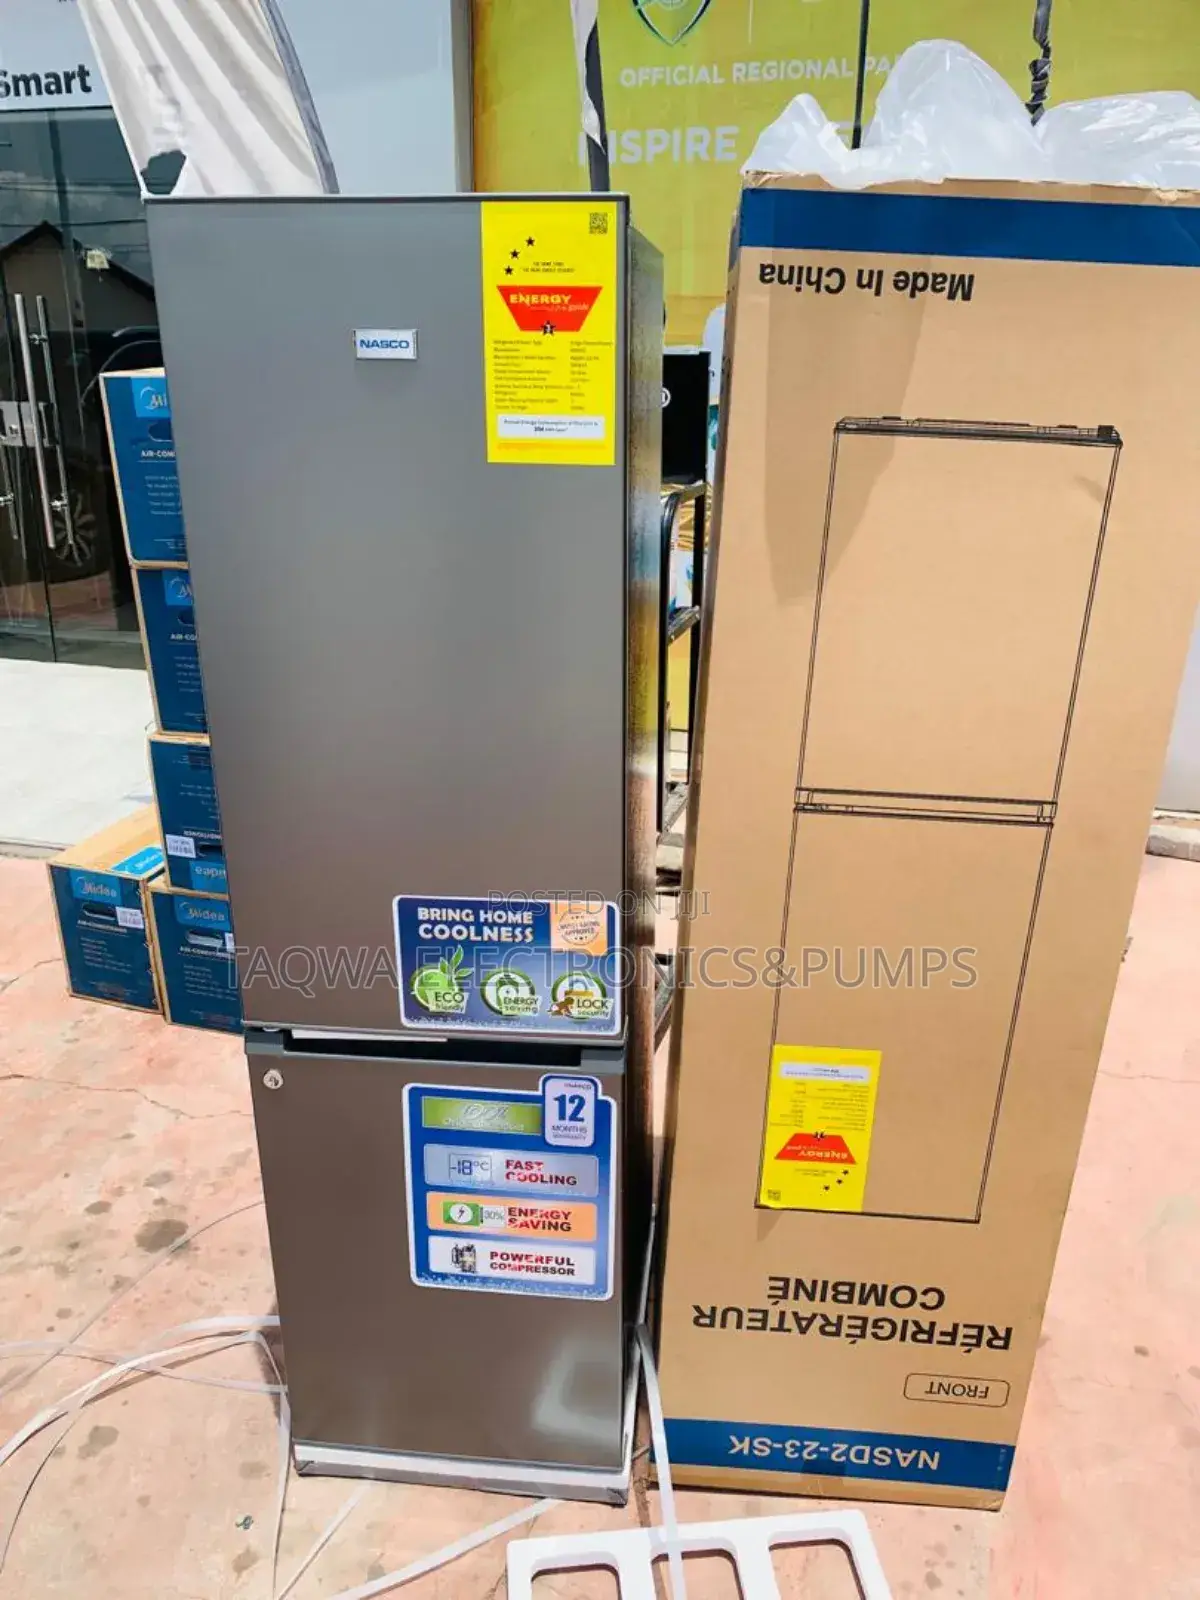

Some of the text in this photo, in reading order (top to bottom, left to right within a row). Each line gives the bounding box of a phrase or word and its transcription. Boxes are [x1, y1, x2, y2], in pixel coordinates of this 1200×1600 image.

[620, 65, 725, 88] OFFICIAL
[732, 57, 854, 82] REGIONAL
[0, 64, 92, 98] Smart
[758, 263, 975, 301] Made In China
[509, 293, 572, 306] ENERGY
[359, 339, 410, 349] NASCO
[417, 907, 534, 924] BRING HOME
[417, 924, 534, 943] COOLNESS
[434, 991, 465, 1003] ECO
[503, 996, 539, 1005] ENERGY
[577, 999, 609, 1010] LOCK
[553, 1095, 586, 1121] 12
[505, 1159, 544, 1171] FAST
[505, 1172, 577, 1186] COOLING
[508, 1207, 572, 1221] ENERGY
[508, 1218, 572, 1232] SAVING
[490, 1251, 575, 1266] POWERFUL
[490, 1261, 575, 1276] COMPRESSOR
[767, 1276, 946, 1311] COMBINÉ
[692, 1305, 1013, 1354] RÉFRIGÉRATEUR
[924, 1380, 990, 1399] FRONT
[728, 1435, 940, 1471] NASD2-23-SK
